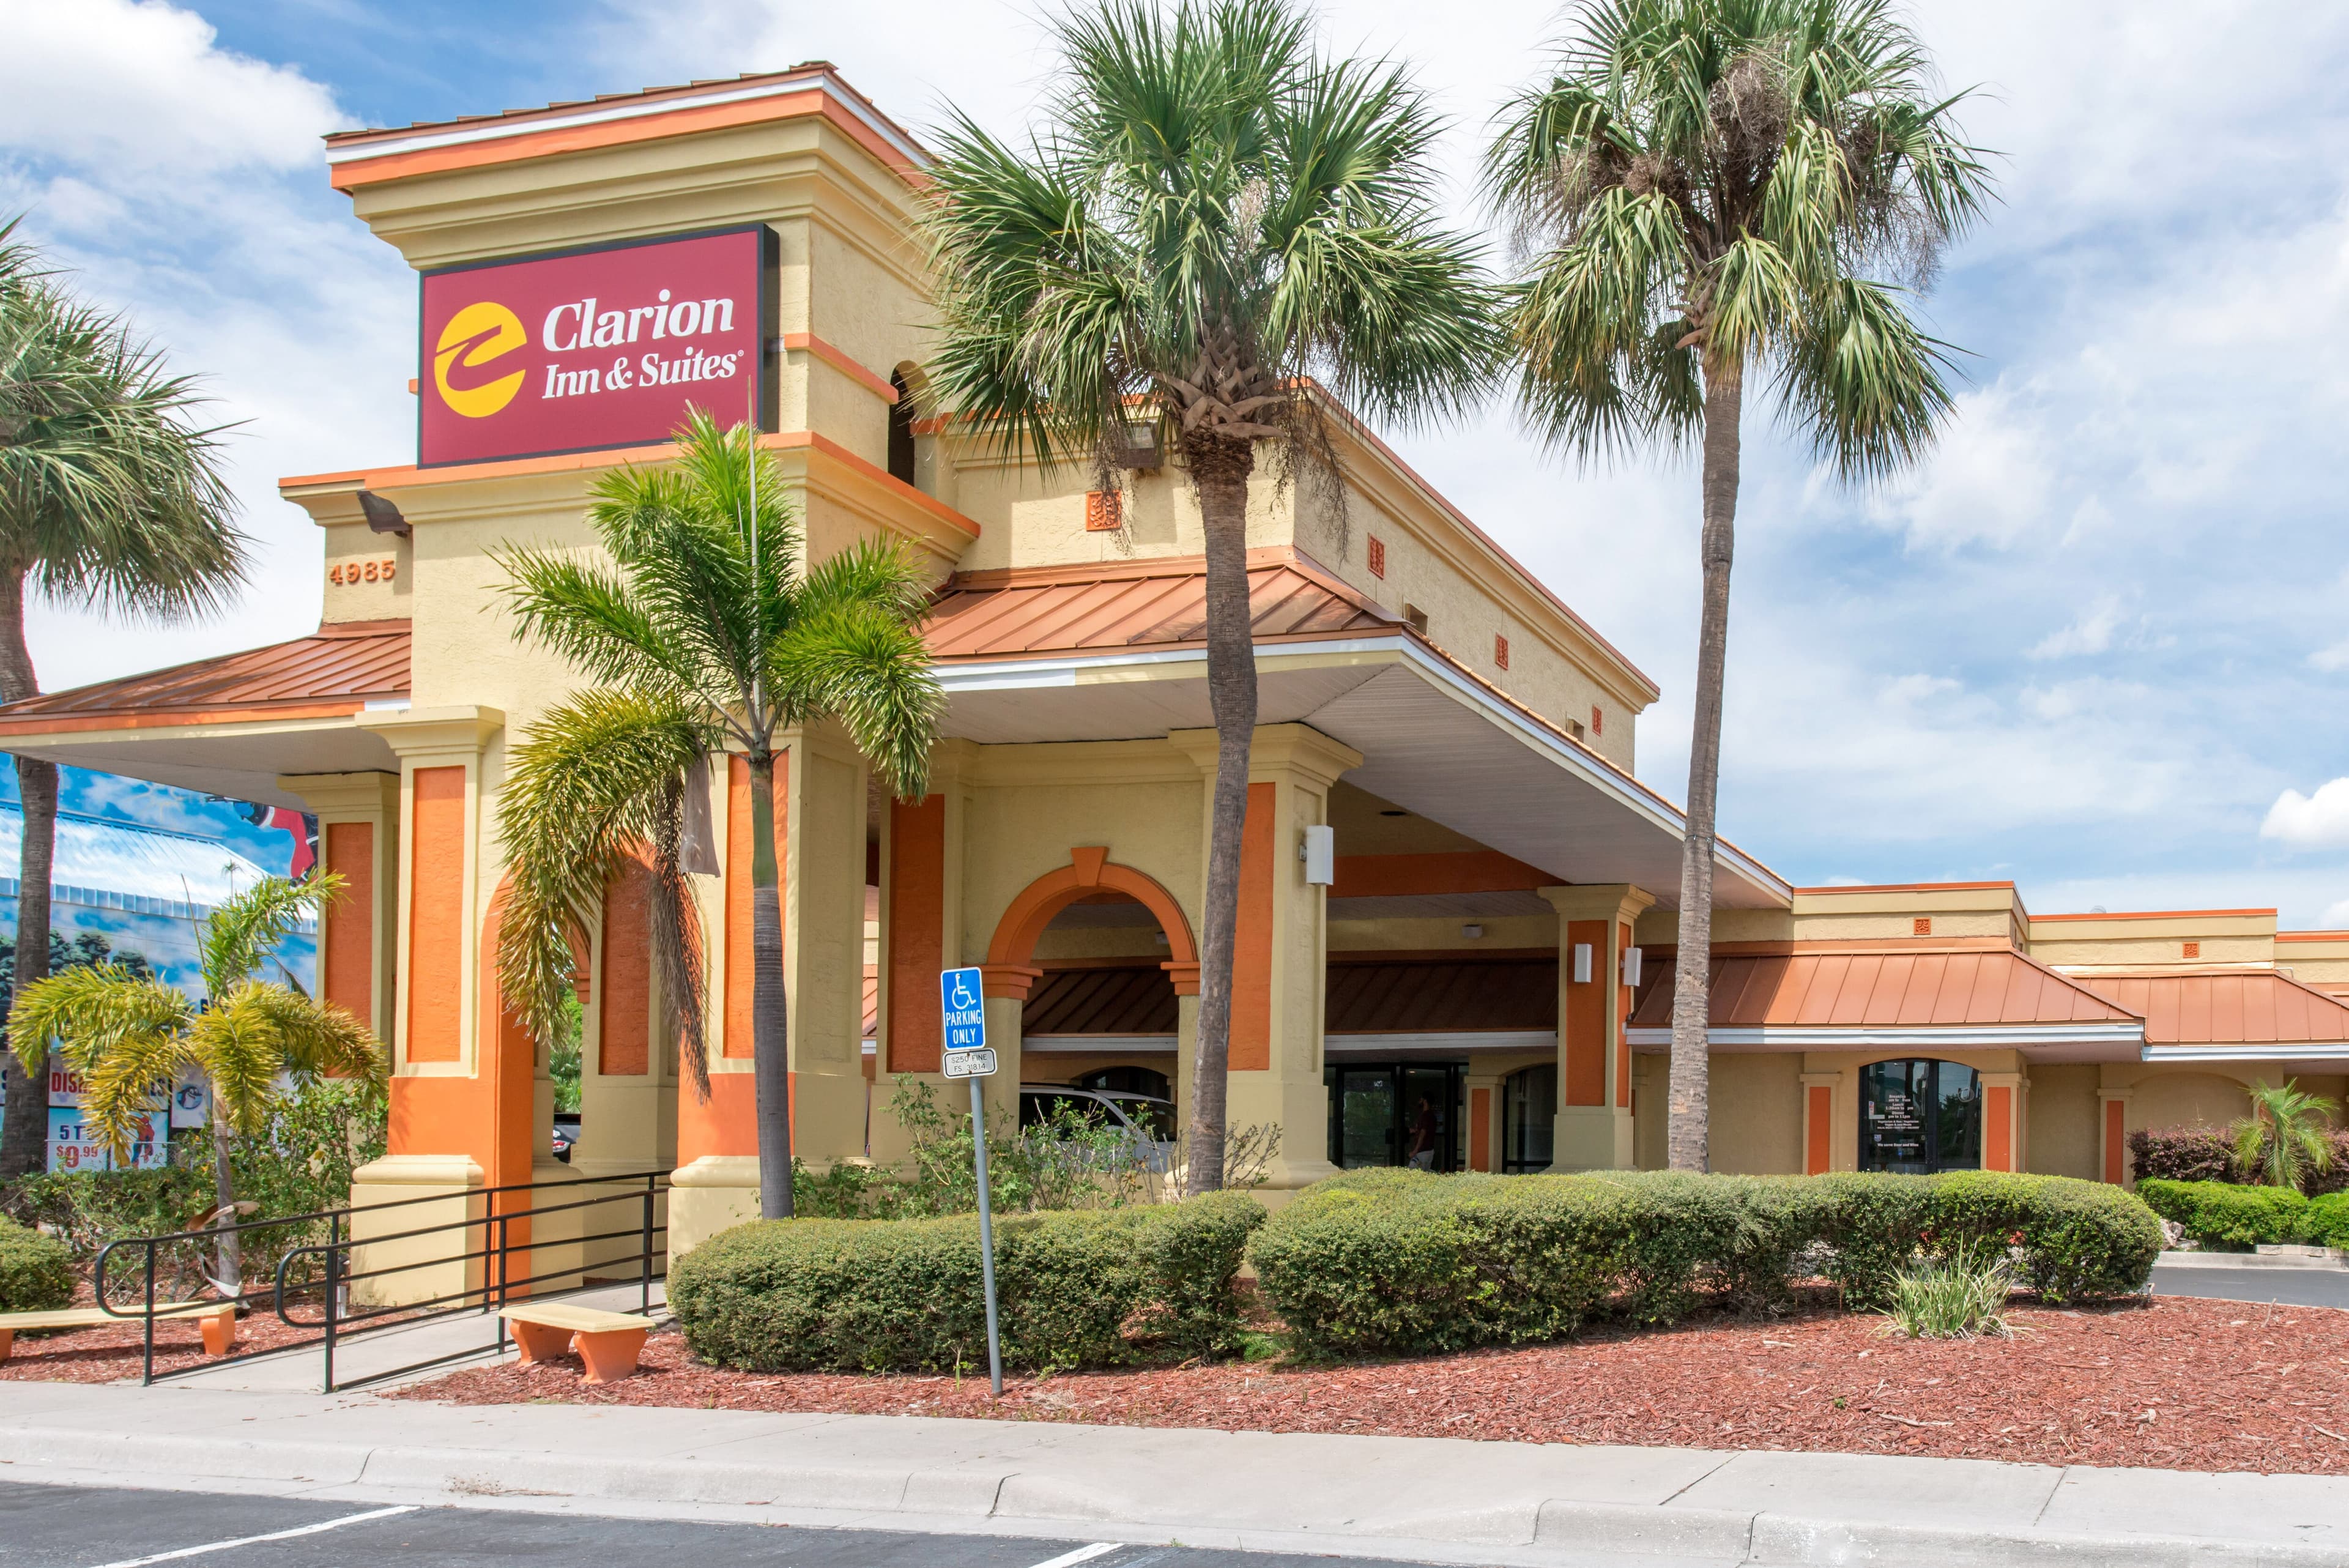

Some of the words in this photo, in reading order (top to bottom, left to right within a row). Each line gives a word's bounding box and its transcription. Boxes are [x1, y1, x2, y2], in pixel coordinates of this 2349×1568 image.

[543, 289, 735, 352] Clarion
[542, 363, 601, 399] Inn
[605, 357, 633, 390] &
[330, 560, 396, 586] 4985
[946, 1009, 982, 1027] PARKING
[952, 1028, 976, 1044] ONLY
[60, 1125, 70, 1140] 5
